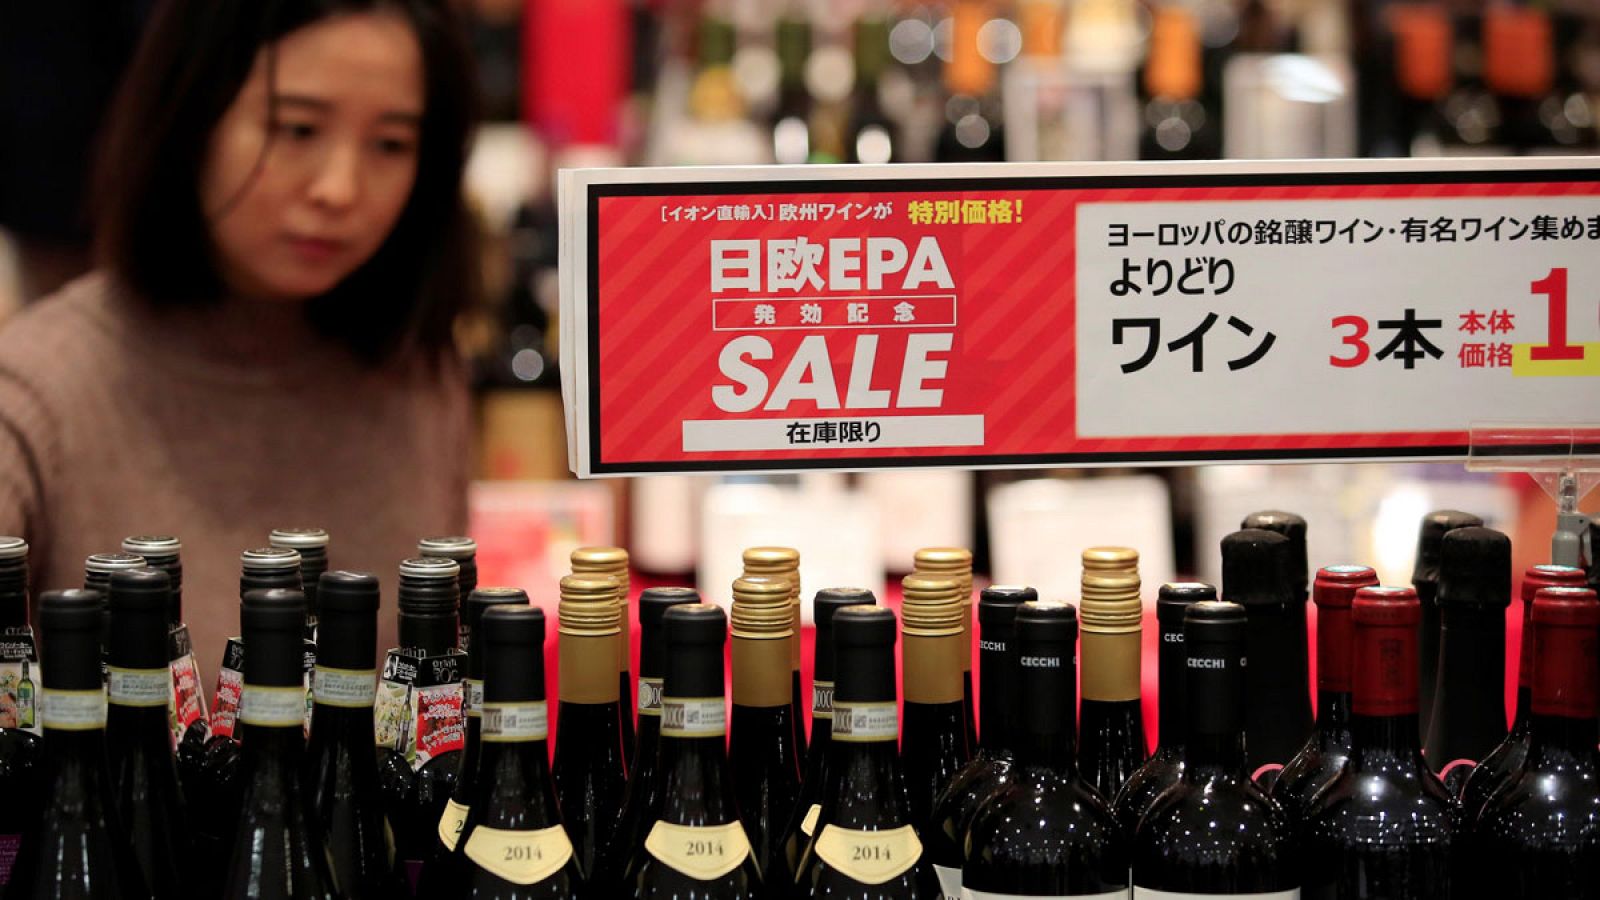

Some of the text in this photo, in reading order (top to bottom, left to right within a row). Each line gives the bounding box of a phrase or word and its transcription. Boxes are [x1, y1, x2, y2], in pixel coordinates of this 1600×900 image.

[710, 236, 955, 293] 日欧EPA
[1109, 256, 1235, 297] よりどり
[754, 302, 916, 325] 発効記念
[1458, 309, 1515, 335] 本体
[1530, 267, 1600, 361] 1
[1112, 309, 1445, 374] ワイン 3本
[1458, 342, 1513, 368] 価格
[711, 332, 954, 413] SALE
[786, 420, 881, 445] 在庫限り
[1020, 656, 1060, 667] CECCHI
[1187, 657, 1225, 669] CECCHI
[504, 846, 542, 861] 2014
[685, 839, 724, 856] 2014
[853, 846, 891, 861] 2014
